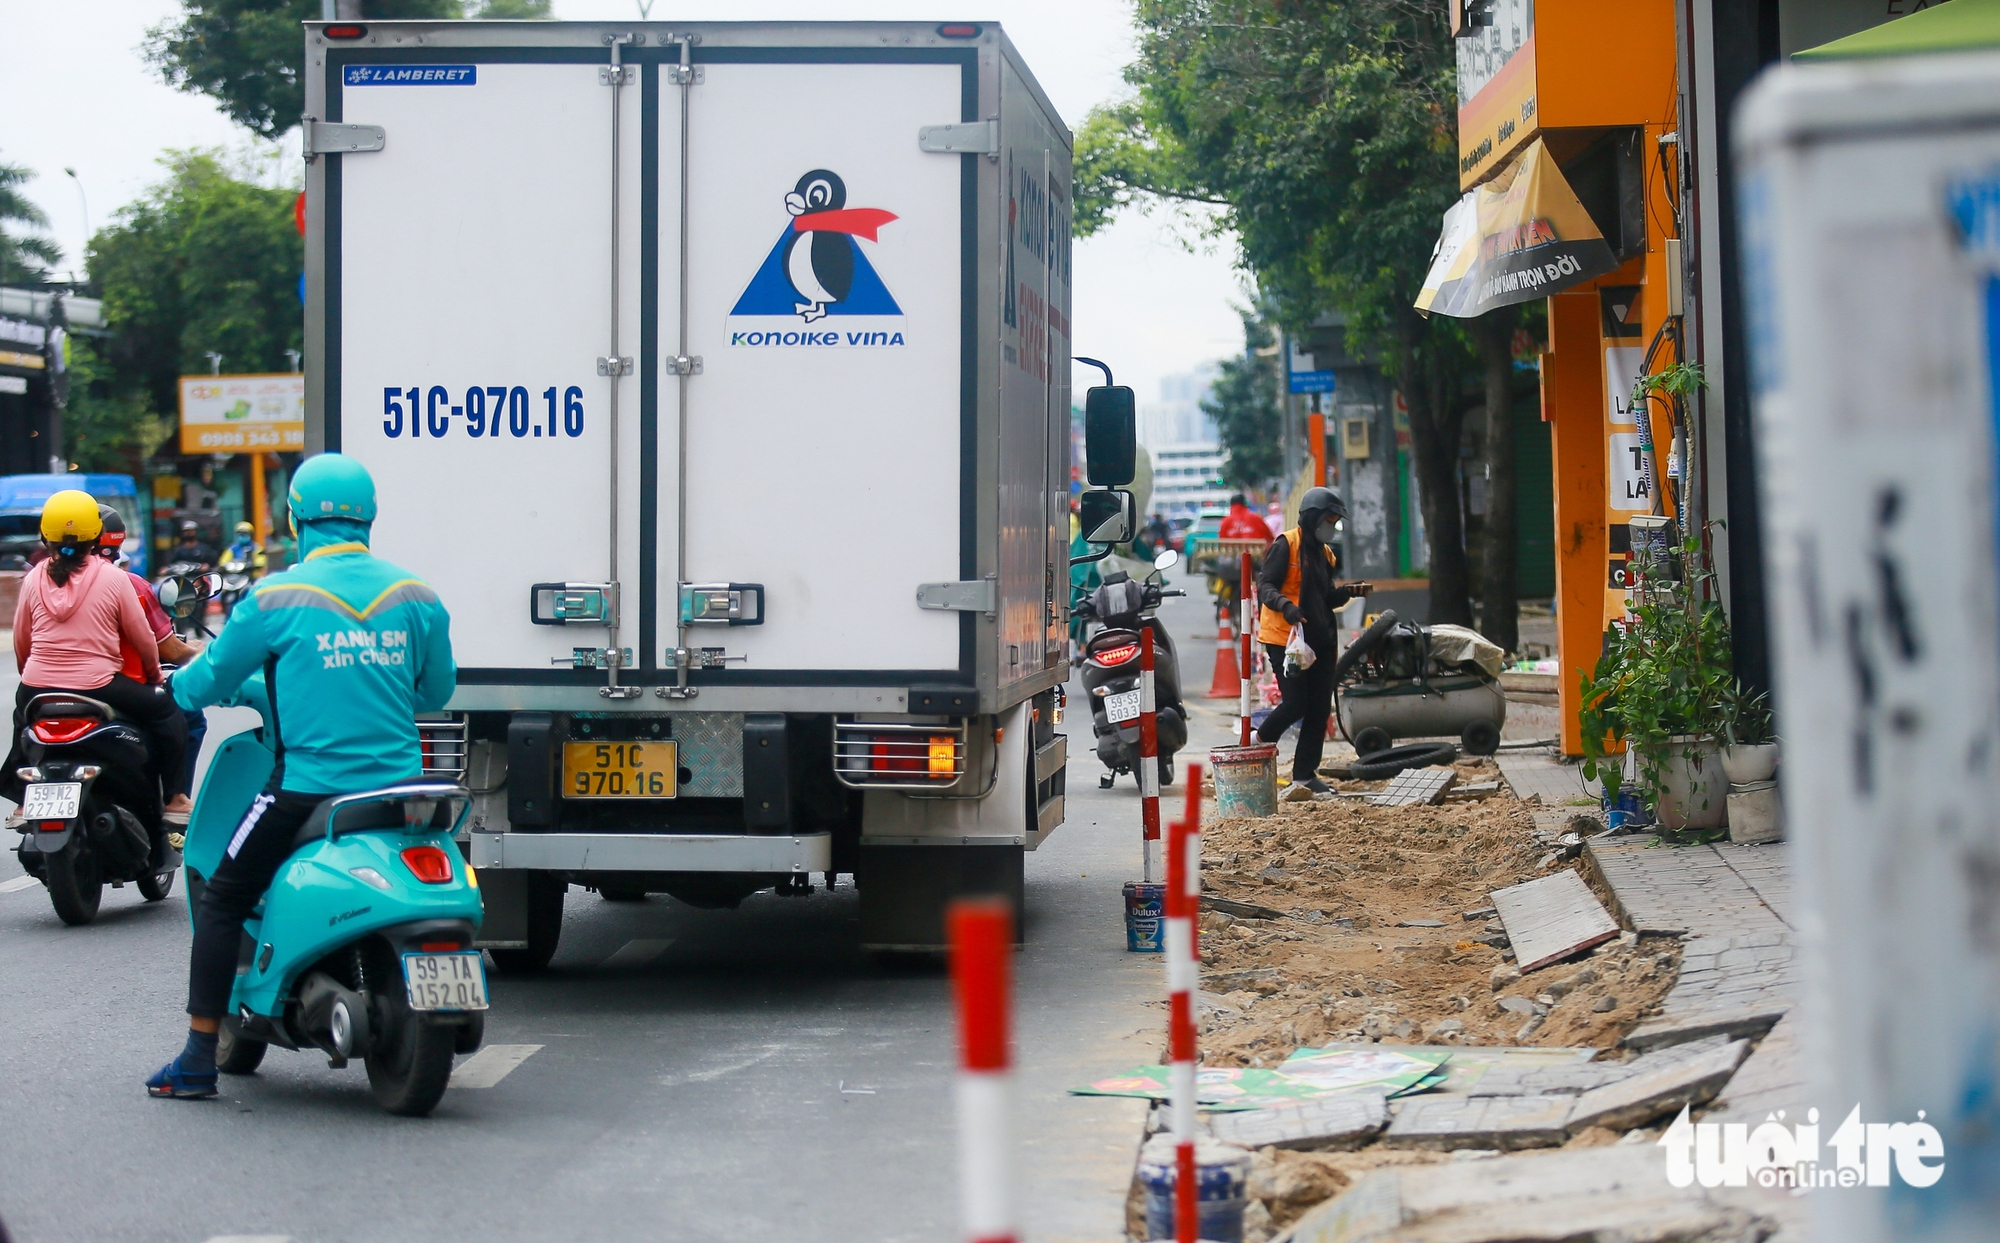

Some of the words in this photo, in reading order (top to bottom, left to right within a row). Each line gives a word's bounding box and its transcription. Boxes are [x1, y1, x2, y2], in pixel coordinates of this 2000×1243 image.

[372, 69, 470, 81] LAMBERET
[1519, 266, 1547, 291] TRỌN
[1545, 254, 1581, 281] ĐỜI
[383, 385, 585, 439] 51C-970.16
[315, 630, 377, 652] XANH
[381, 630, 407, 648] SM
[322, 649, 355, 670] xin
[1110, 704, 1140, 722] 503.3
[595, 744, 644, 768] 51C
[575, 771, 664, 795] 970.16
[27, 801, 76, 818] 227.48
[1132, 907, 1158, 917] Dulux
[415, 956, 473, 981] 59-TA
[417, 982, 481, 1007] 152.04
